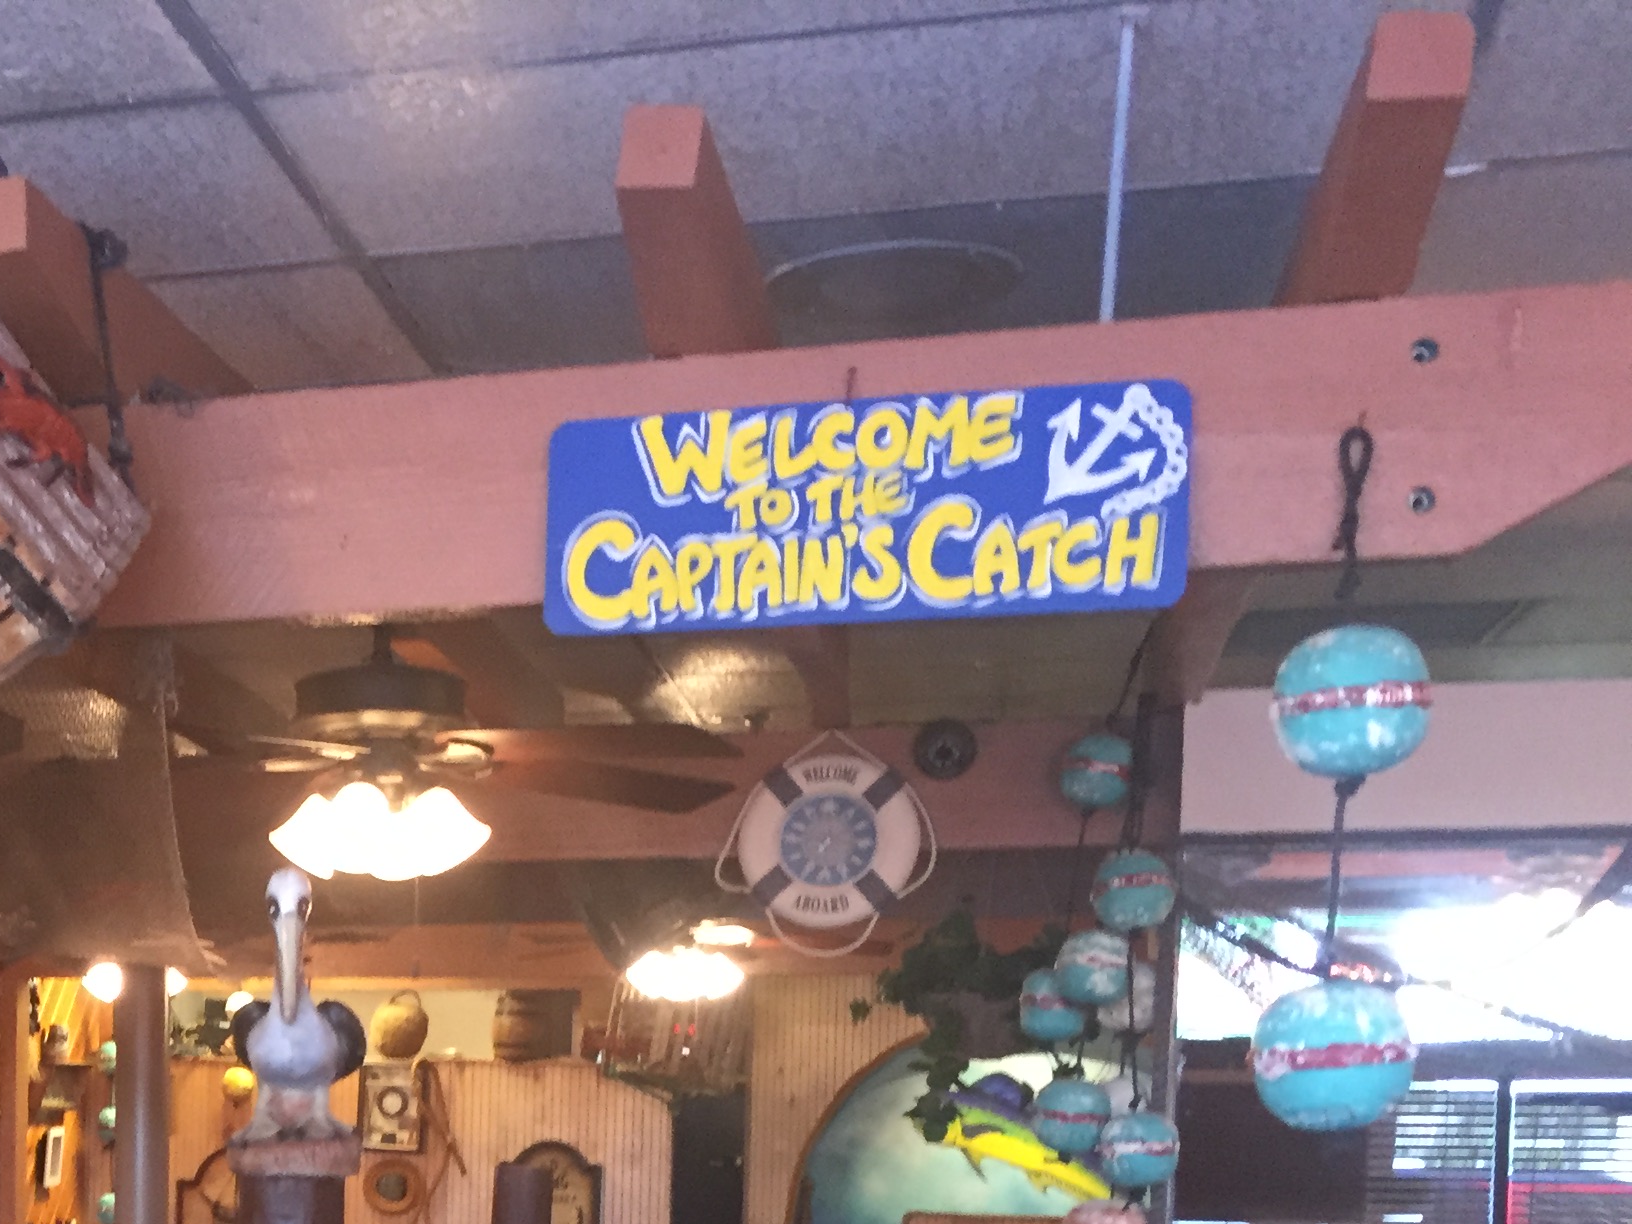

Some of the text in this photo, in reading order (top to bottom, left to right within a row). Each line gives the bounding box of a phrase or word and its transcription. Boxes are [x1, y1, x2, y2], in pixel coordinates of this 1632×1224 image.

[632, 391, 1024, 505] WELCOME
[725, 470, 914, 533] TO THE
[563, 494, 1168, 630] CAPTAIN'S CATCH
[802, 764, 859, 786] WELCOME
